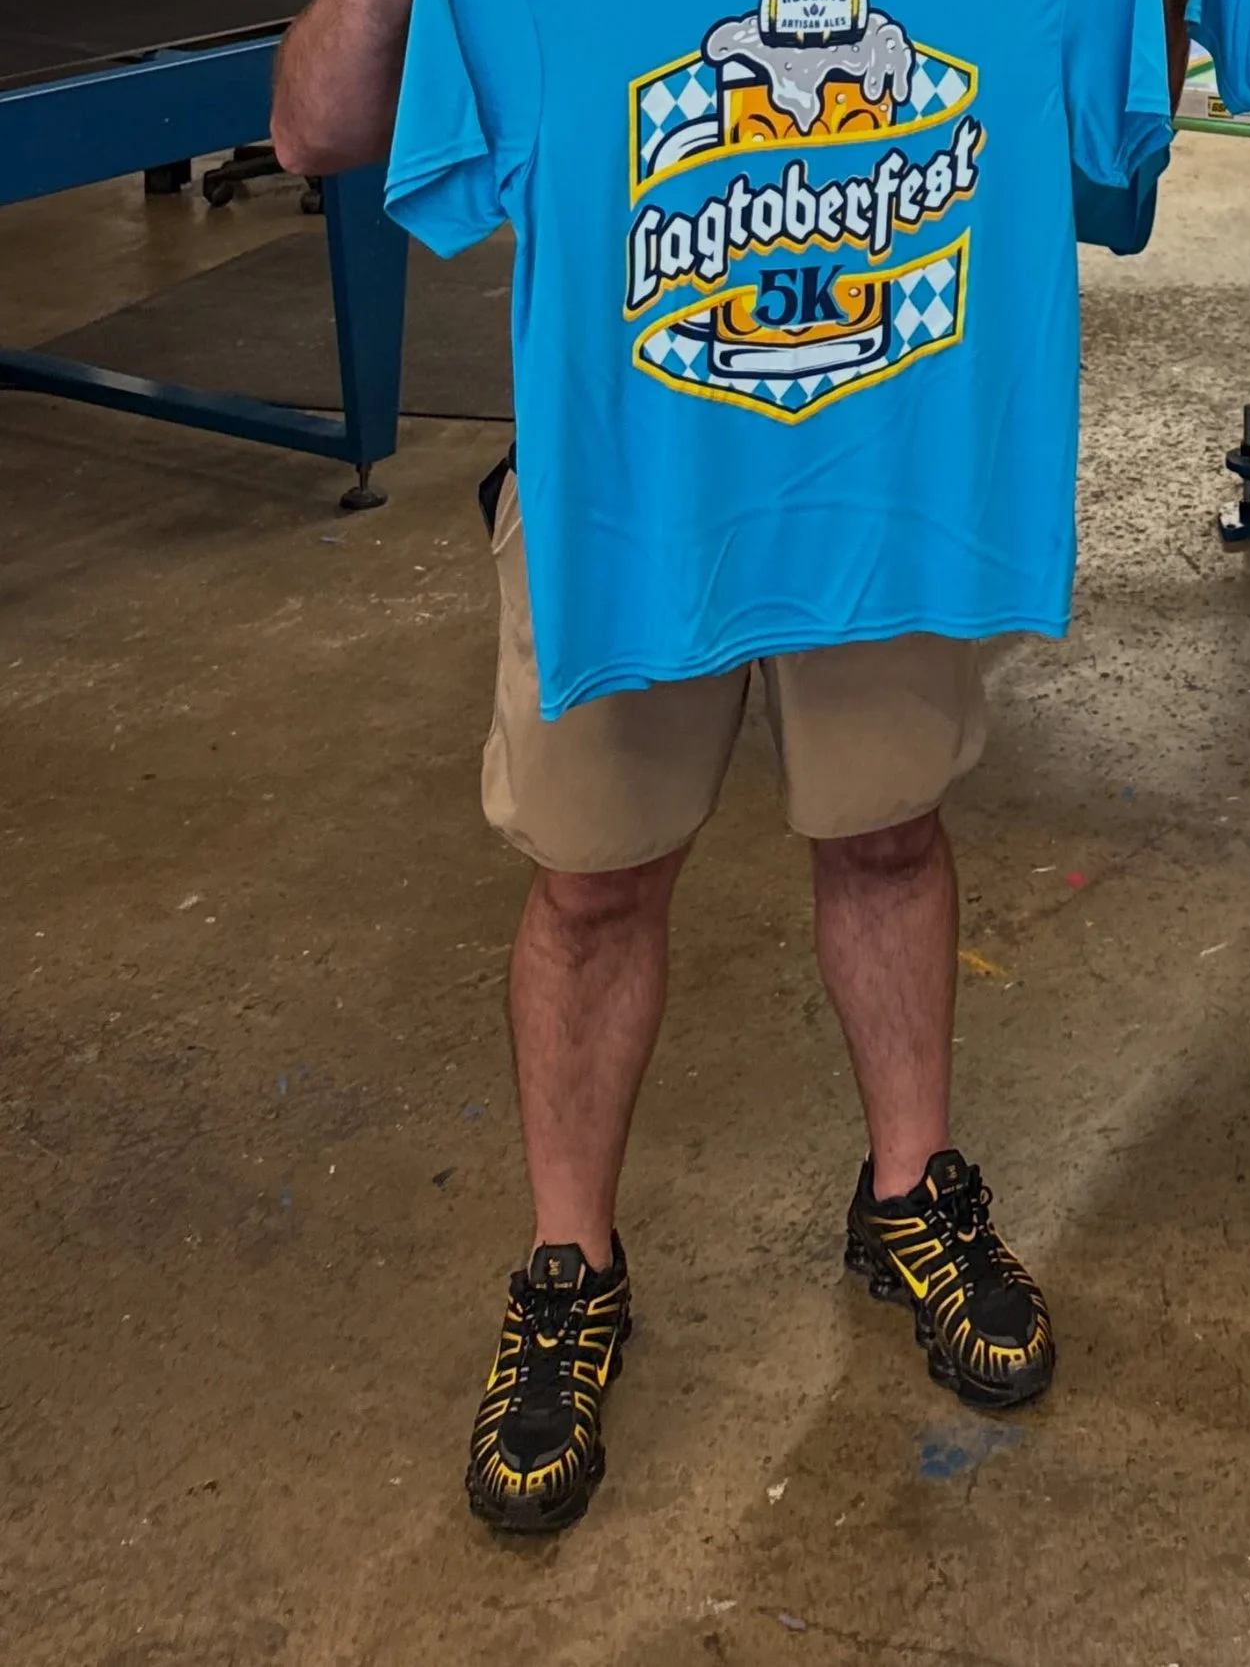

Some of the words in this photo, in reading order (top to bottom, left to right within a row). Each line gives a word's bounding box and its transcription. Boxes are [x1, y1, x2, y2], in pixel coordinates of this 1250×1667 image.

[781, 17, 821, 29] ARTISAN
[824, 16, 846, 27] ALES
[626, 117, 984, 314] Lagtoberfest
[756, 265, 847, 328] 5K
